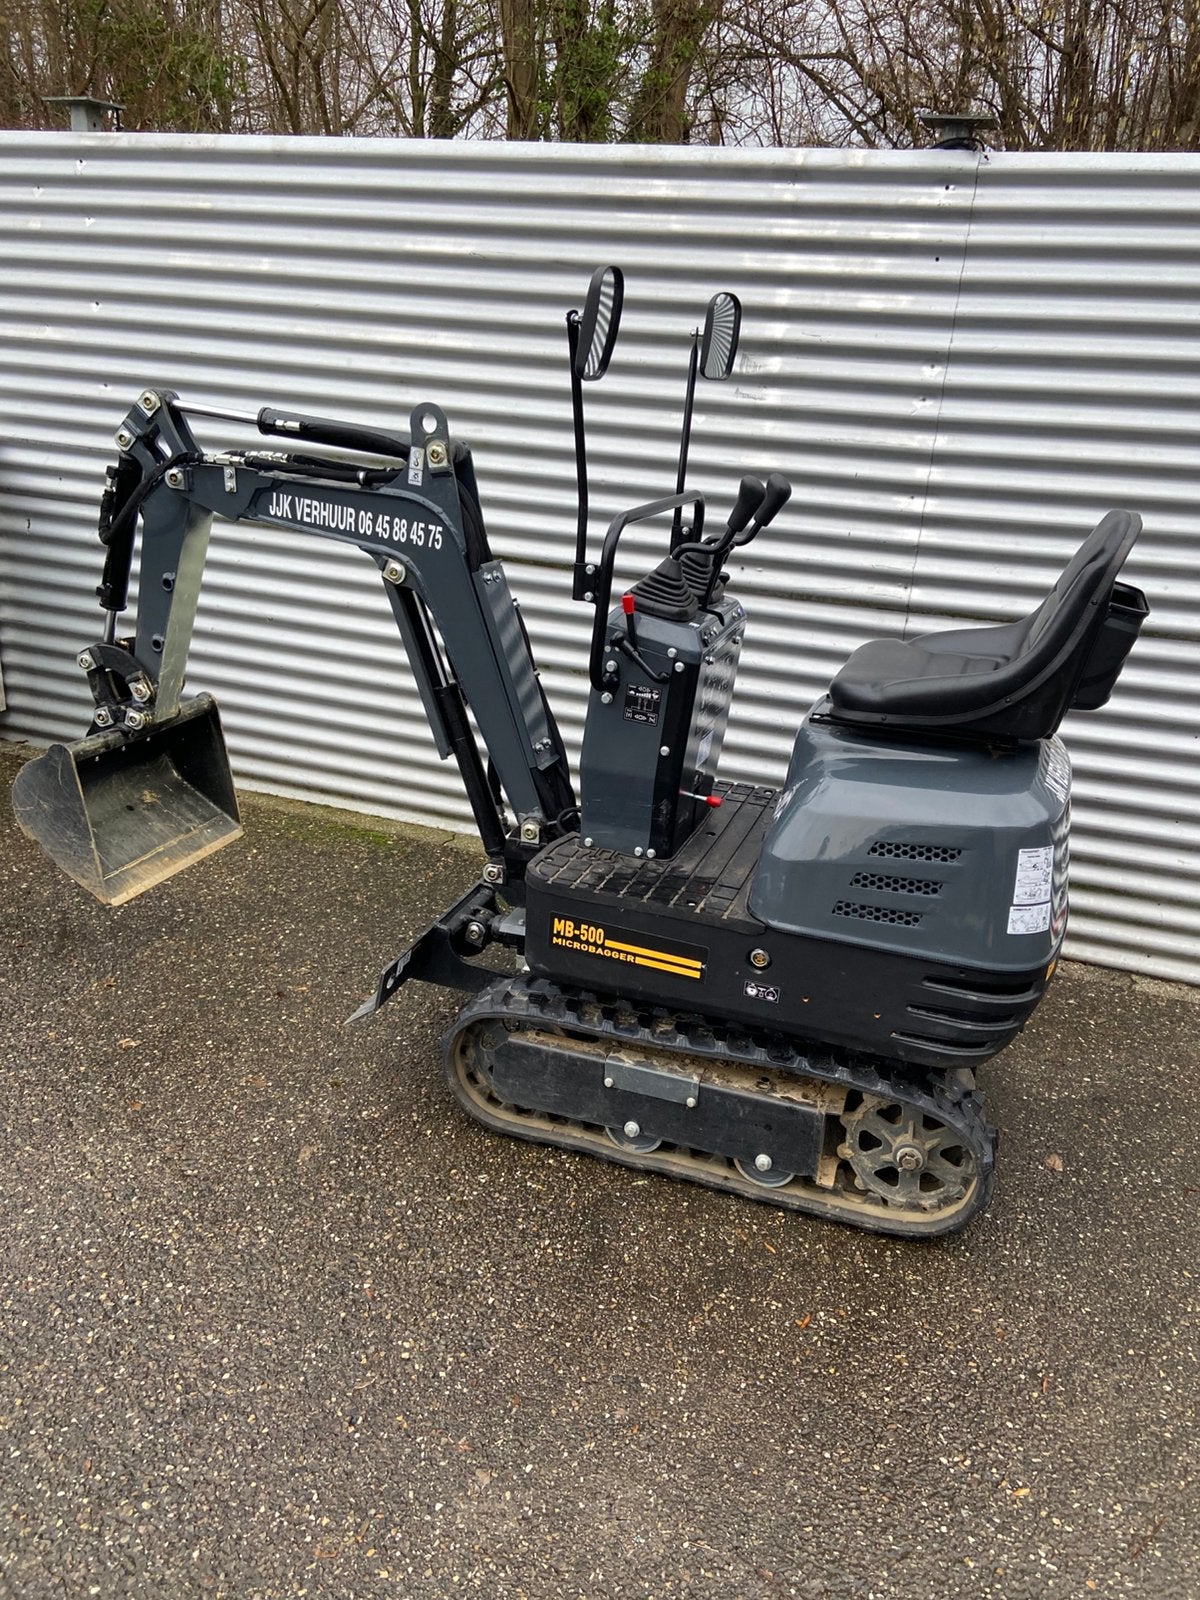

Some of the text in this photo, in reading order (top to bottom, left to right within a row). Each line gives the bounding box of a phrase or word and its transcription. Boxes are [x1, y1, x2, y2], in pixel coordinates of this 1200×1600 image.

[269, 492, 443, 550] JJK VERHUUR 06 45 88 45 75
[553, 917, 605, 945] MB-500
[552, 936, 637, 964] MICROBAGGER
